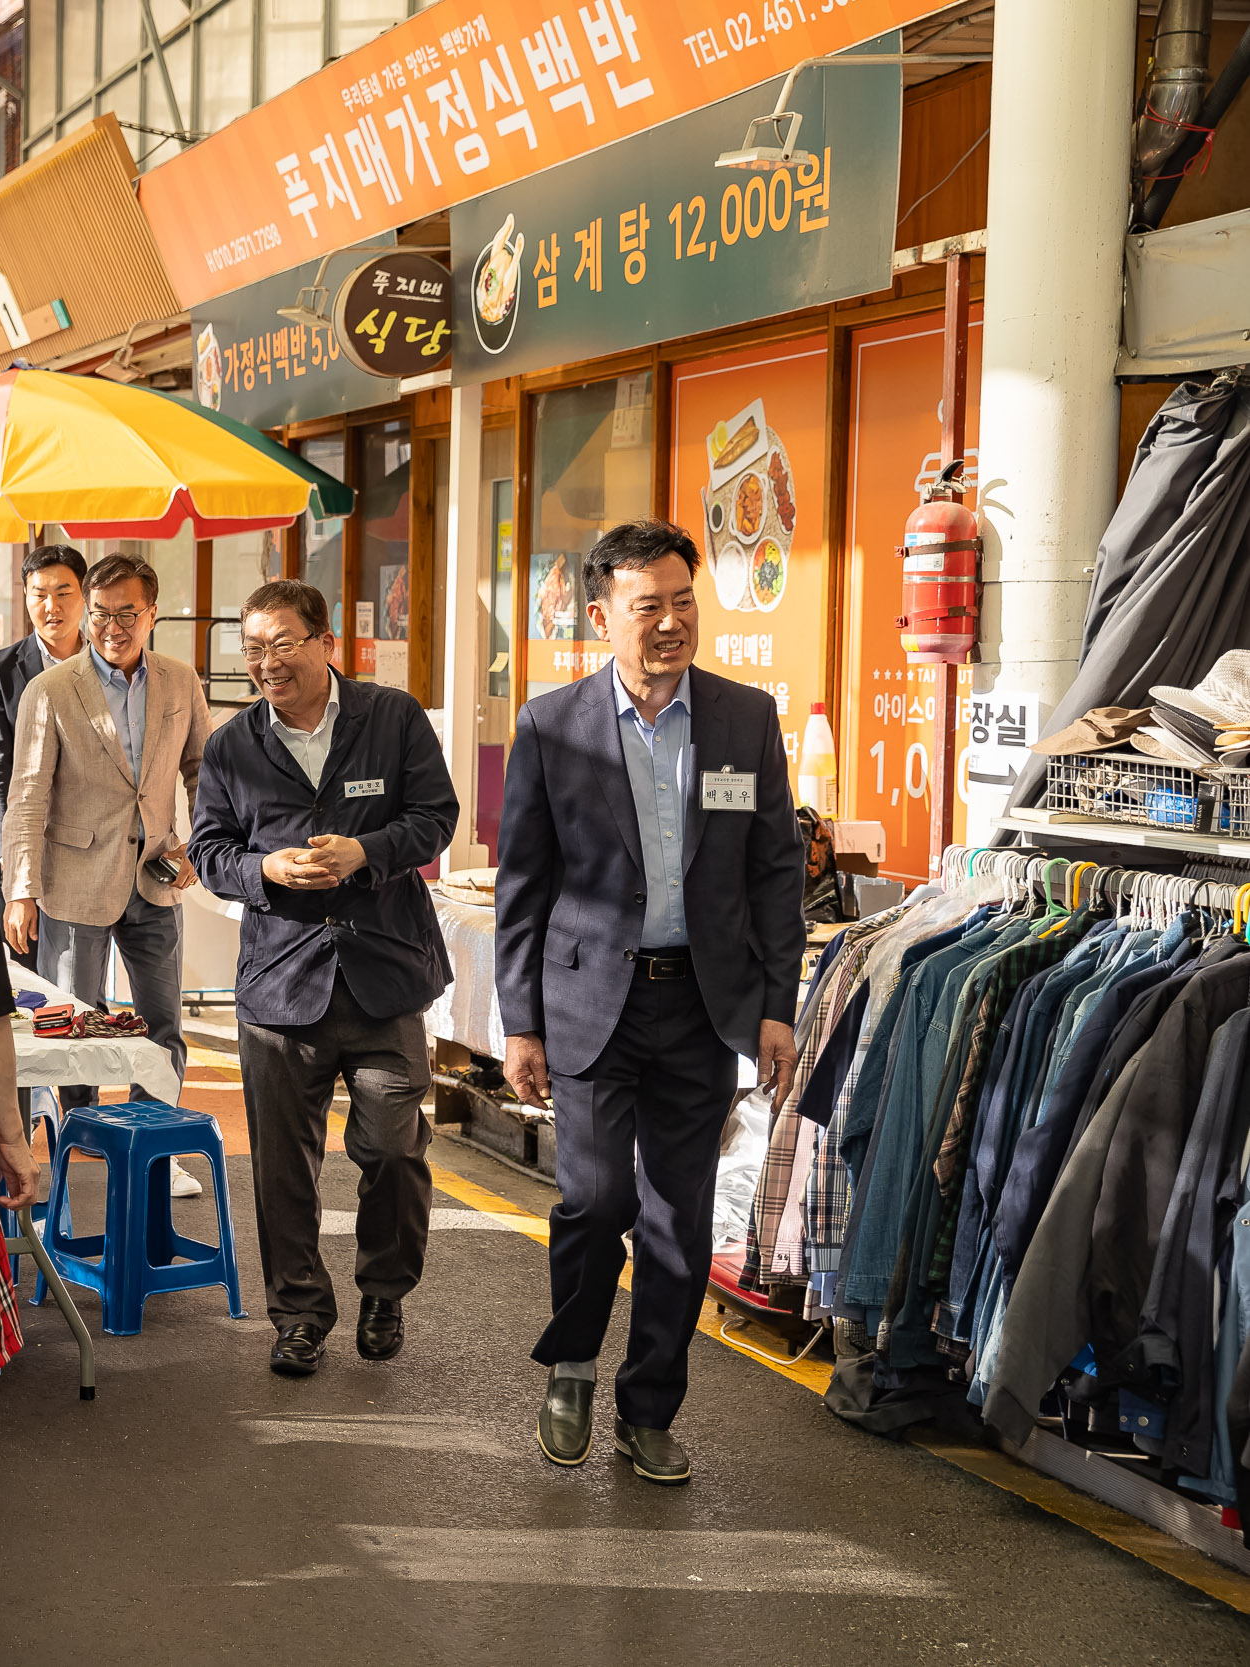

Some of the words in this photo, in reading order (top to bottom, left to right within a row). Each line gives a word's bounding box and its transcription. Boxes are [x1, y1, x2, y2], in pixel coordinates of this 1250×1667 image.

[341, 72, 384, 113] 우리동네
[381, 60, 407, 90] 가장
[405, 44, 442, 80] 맛있는
[439, 13, 492, 59] 백반가게
[683, 27, 728, 69] TEL
[275, 0, 655, 239] 푸지매가정식백반
[667, 146, 831, 262] 12,000원
[223, 322, 308, 392] 가정식백반
[354, 308, 452, 357] 식당
[715, 633, 773, 667] 매일매일
